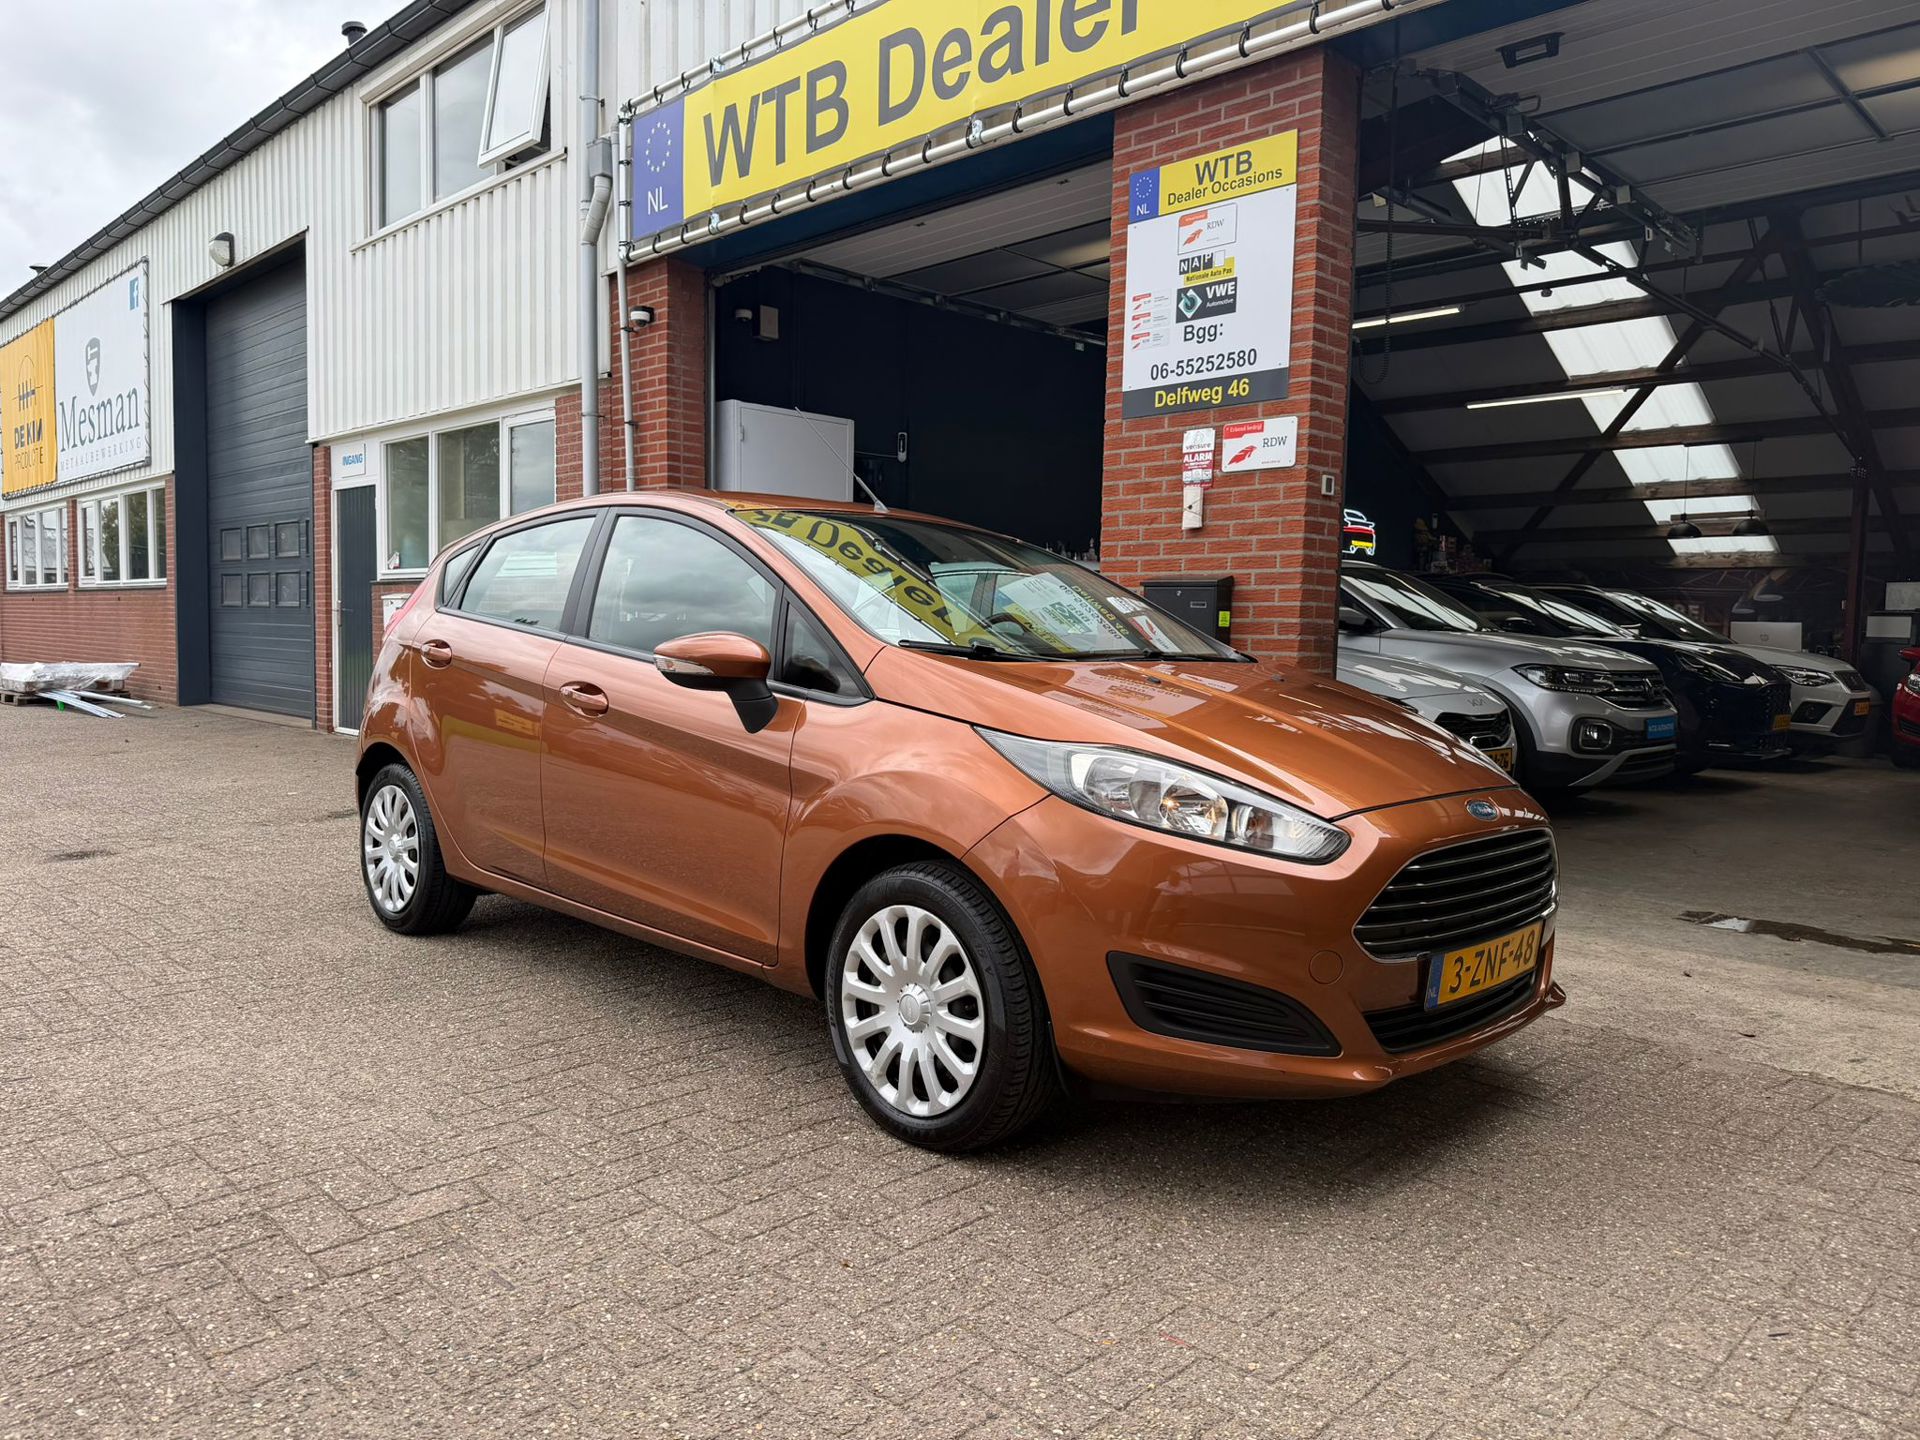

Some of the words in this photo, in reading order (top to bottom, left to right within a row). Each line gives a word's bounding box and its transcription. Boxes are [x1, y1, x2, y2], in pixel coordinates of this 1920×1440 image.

[703, 58, 850, 187] WTB
[1195, 150, 1253, 187] WTB
[1167, 185, 1208, 207] Dealer
[1213, 166, 1283, 196] Occasions
[647, 191, 669, 216] NL
[1136, 203, 1150, 216] NL
[1206, 218, 1225, 231] RDW
[1205, 281, 1236, 299] VWE
[1205, 298, 1234, 308] Automotive
[1183, 322, 1224, 344] Bgg:
[1150, 348, 1258, 381] 06-55252580
[1154, 384, 1222, 409] Delfweg
[1227, 378, 1250, 398] 46
[59, 386, 140, 453] Mesman
[1262, 436, 1288, 448] RDW
[342, 453, 363, 466] INGANG
[1183, 452, 1213, 463] ALARM
[1449, 929, 1536, 993] 3-ZNF-48
